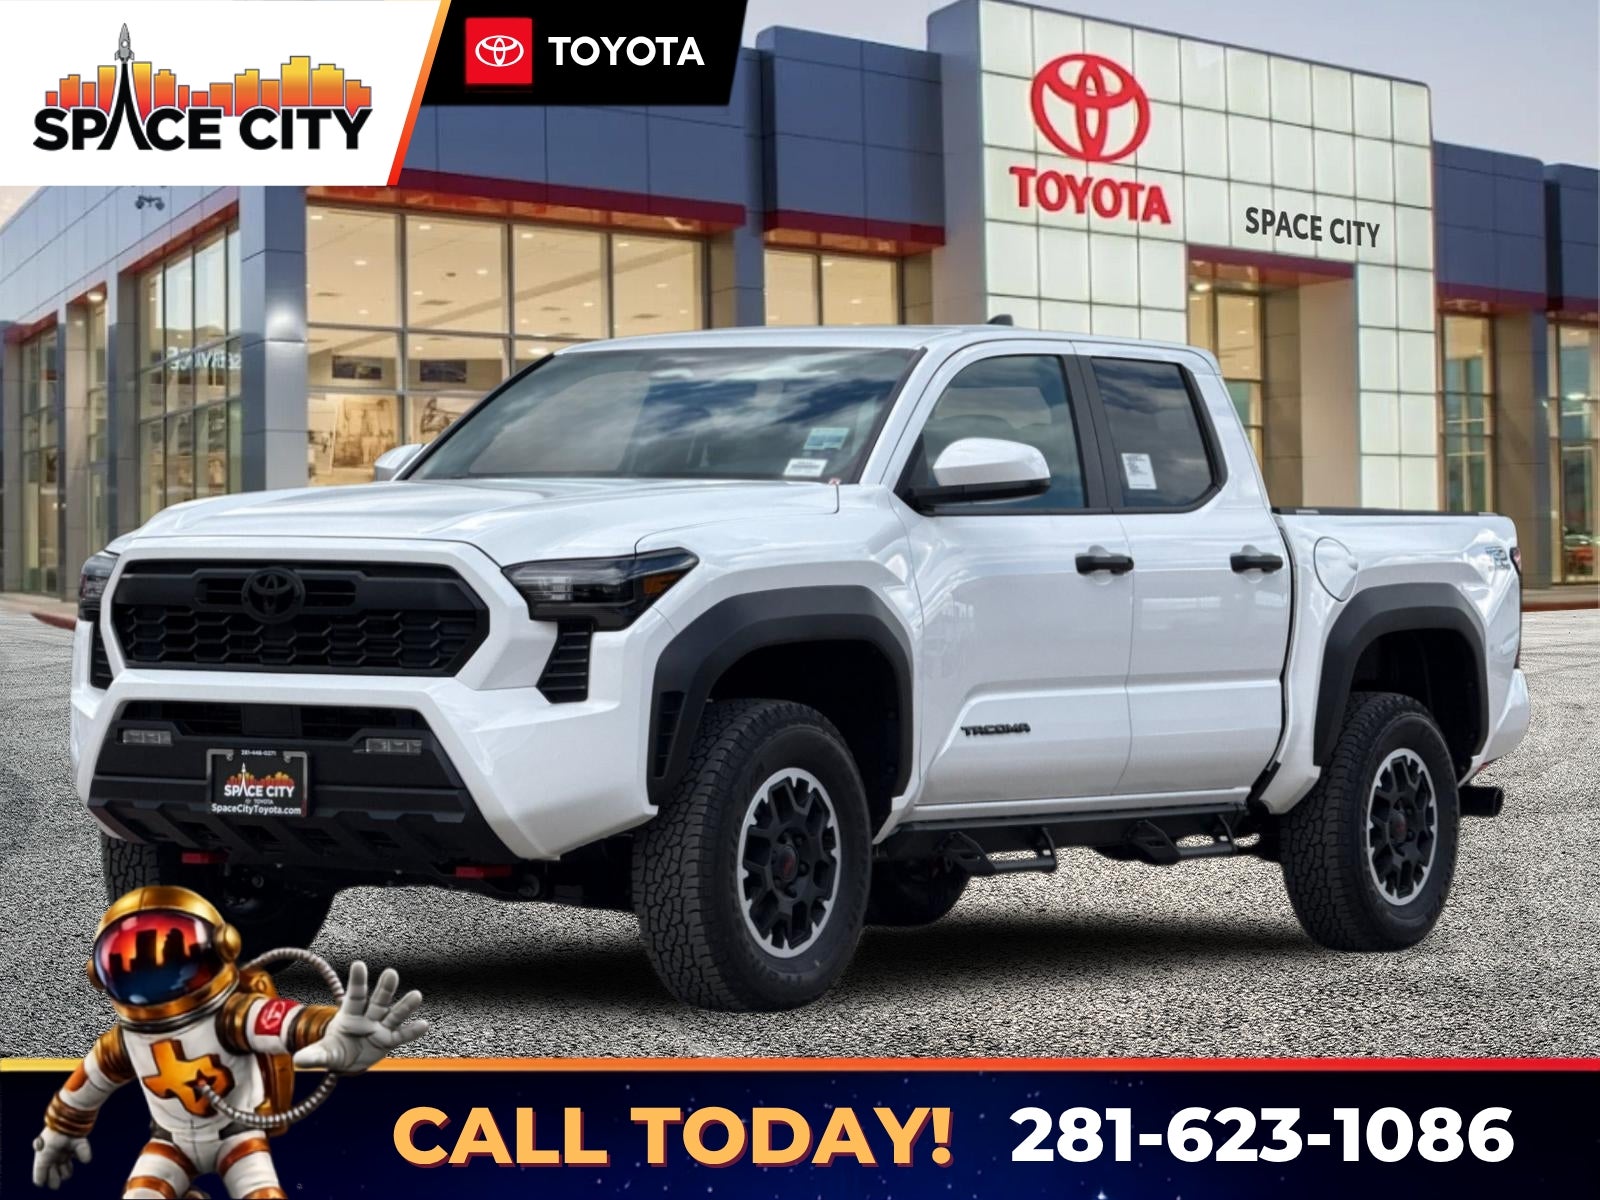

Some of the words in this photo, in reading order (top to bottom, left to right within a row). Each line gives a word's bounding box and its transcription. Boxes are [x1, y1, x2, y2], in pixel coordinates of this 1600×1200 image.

[1009, 166, 1171, 224] TOYOTA
[1245, 206, 1322, 241] SPACE
[1329, 217, 1380, 248] CITY
[960, 722, 1031, 736] TACOMA
[265, 785, 295, 798] CITY
[211, 803, 302, 815] SpaceCityToyota.com
